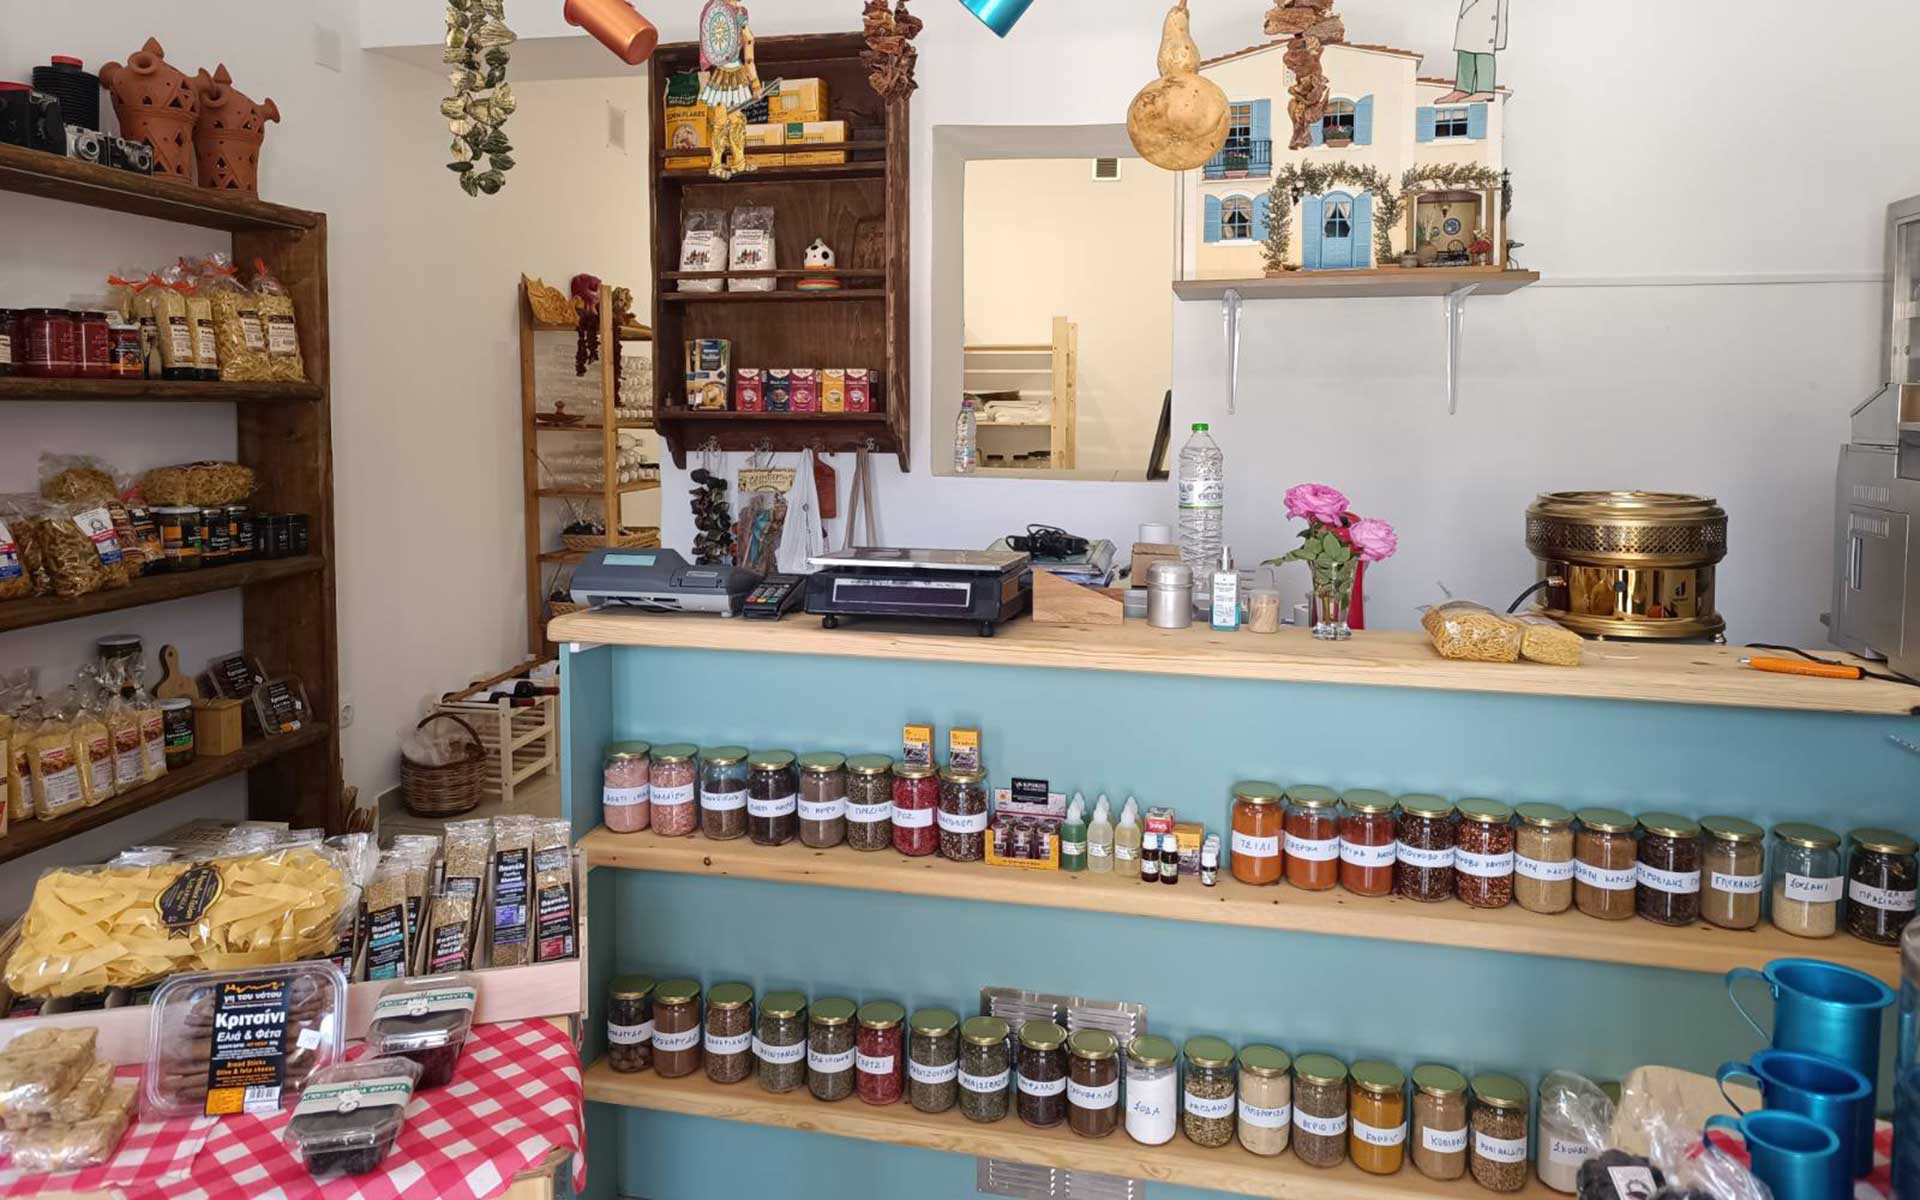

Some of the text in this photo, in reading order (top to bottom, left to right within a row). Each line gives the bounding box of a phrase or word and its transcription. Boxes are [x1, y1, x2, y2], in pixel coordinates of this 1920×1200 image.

[683, 110, 705, 119] FLAKES
[224, 995, 235, 1004] γη
[255, 990, 282, 999] νότου
[215, 1008, 286, 1030] Κριτσίνι
[216, 1028, 282, 1042] Ελιά & Φέτα
[1133, 1100, 1161, 1116] ΣΟΔΑ
